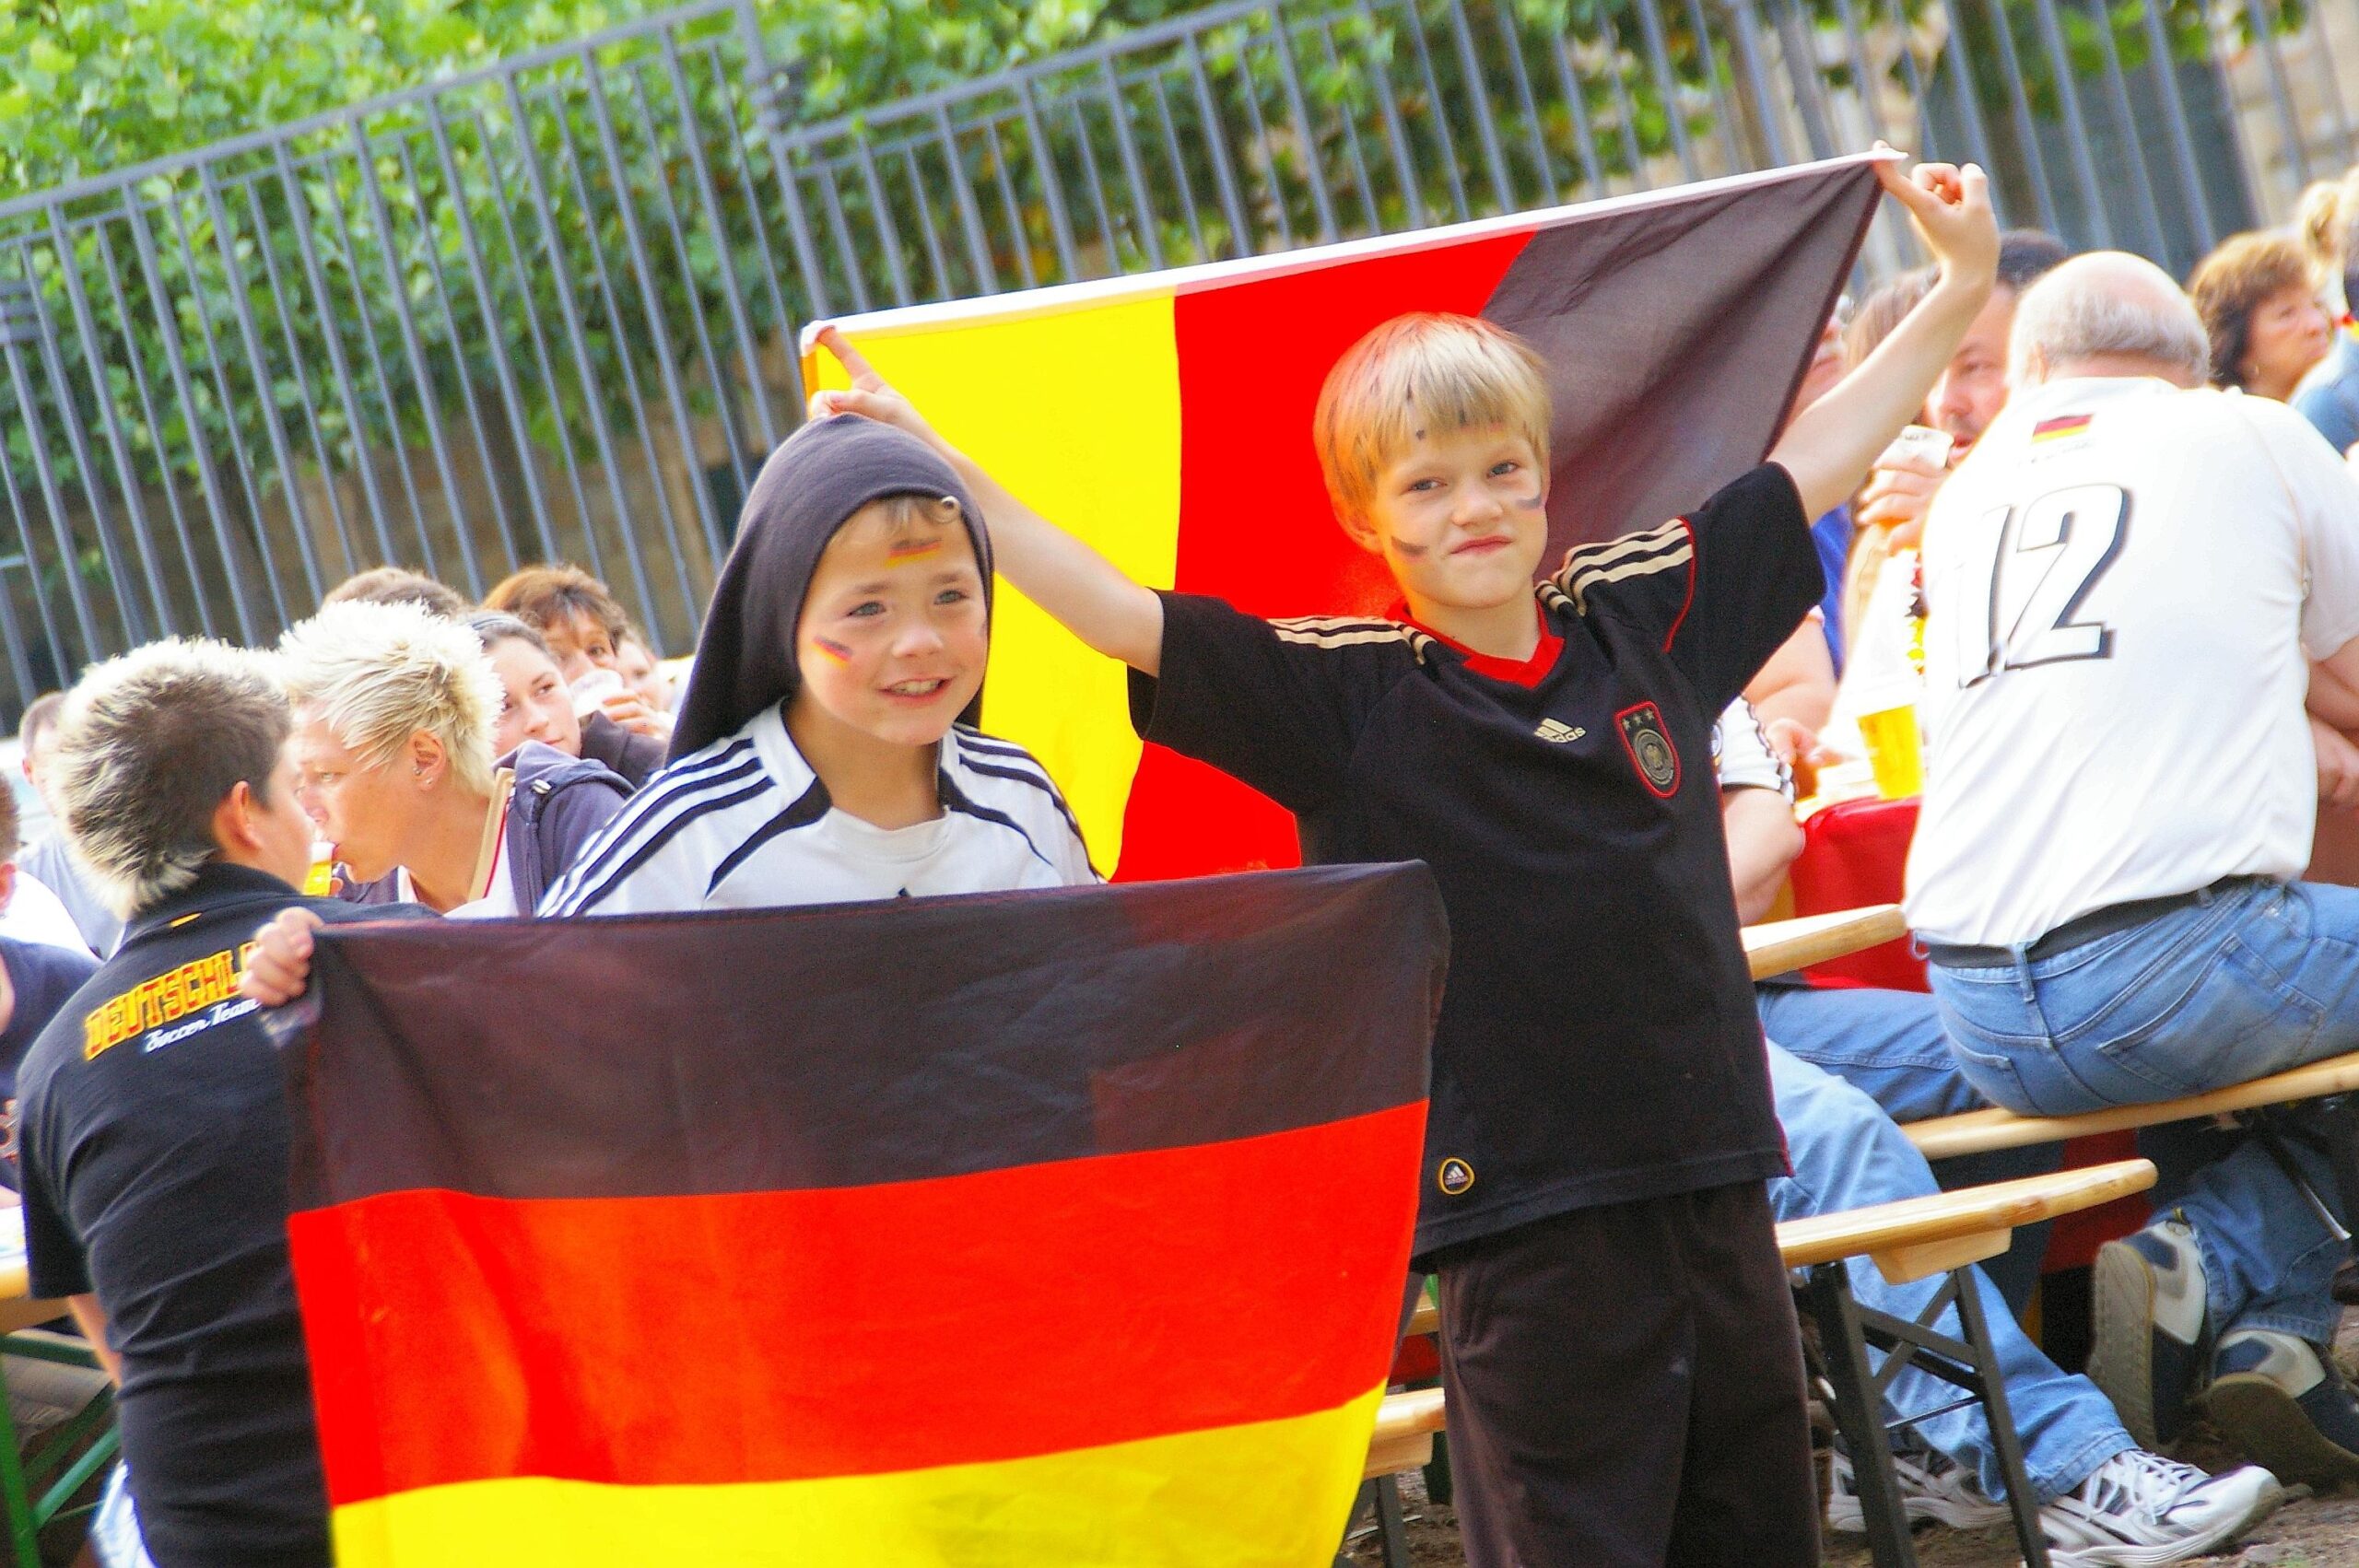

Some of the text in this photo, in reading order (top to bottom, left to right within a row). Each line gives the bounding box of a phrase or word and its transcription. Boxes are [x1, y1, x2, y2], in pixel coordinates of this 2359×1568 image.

[1957, 483, 2136, 690] 12
[1538, 726, 1586, 743] das
[84, 942, 256, 1061] DEUTSCHL
[209, 998, 263, 1027] Team
